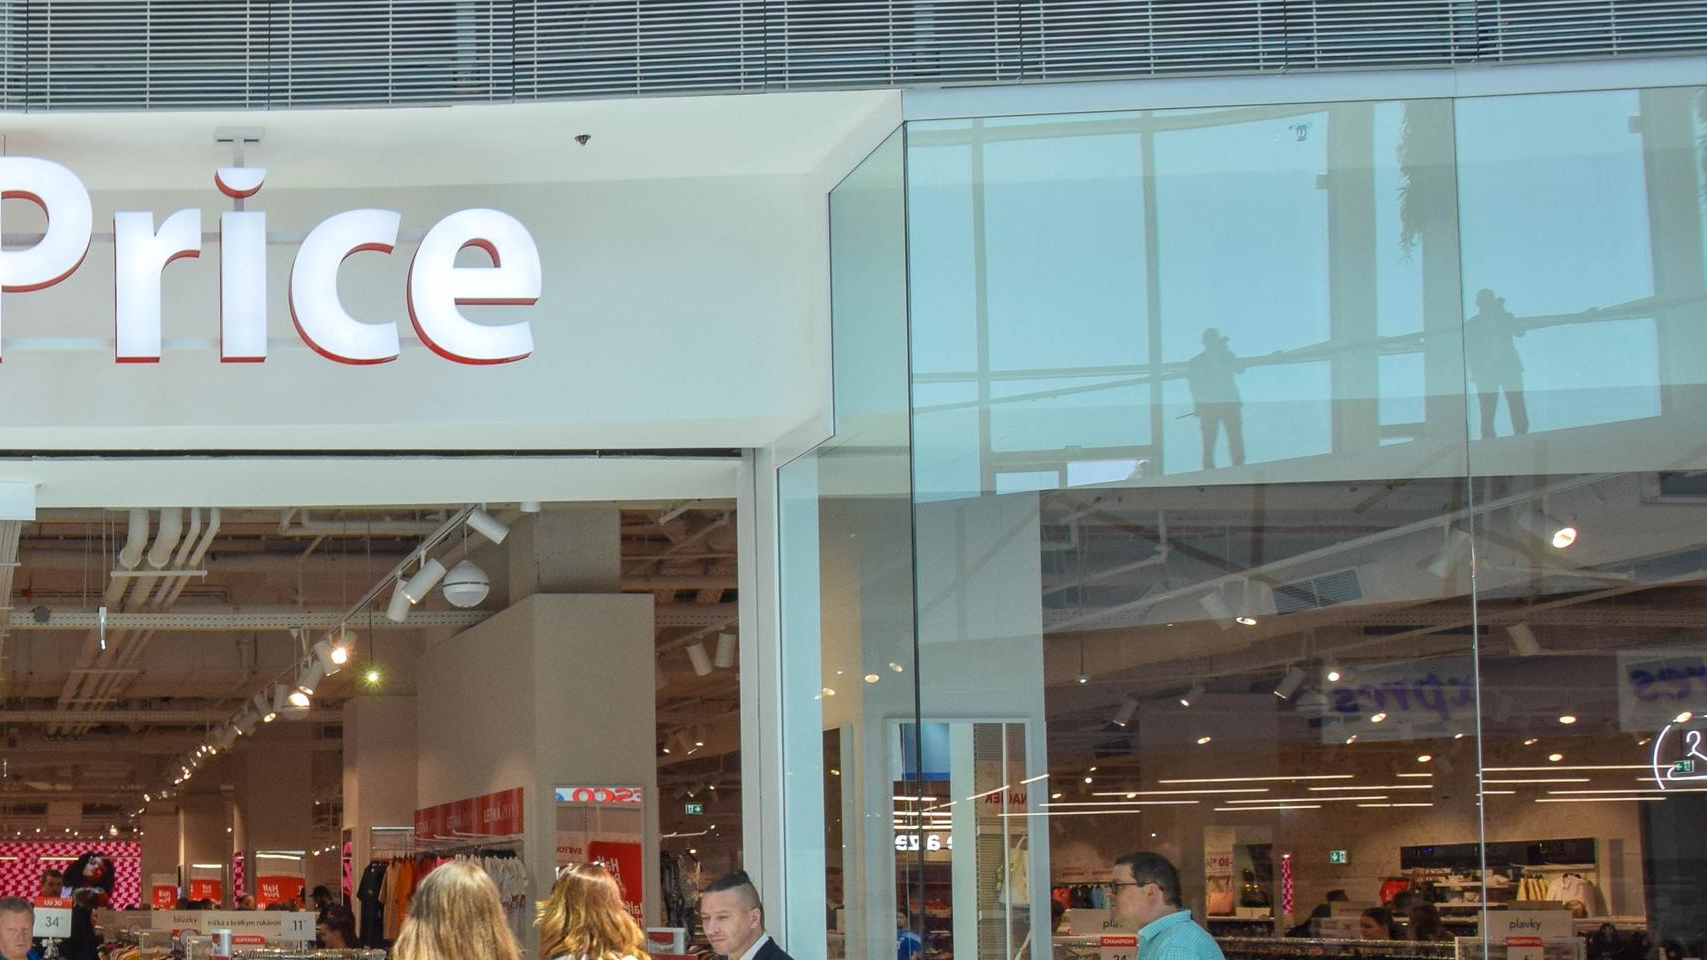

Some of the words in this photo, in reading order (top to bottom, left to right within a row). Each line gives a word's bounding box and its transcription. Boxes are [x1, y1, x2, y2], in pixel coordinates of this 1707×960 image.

[45, 916, 60, 928] 34
[293, 920, 303, 931] 11
[1509, 918, 1542, 931] plavky
